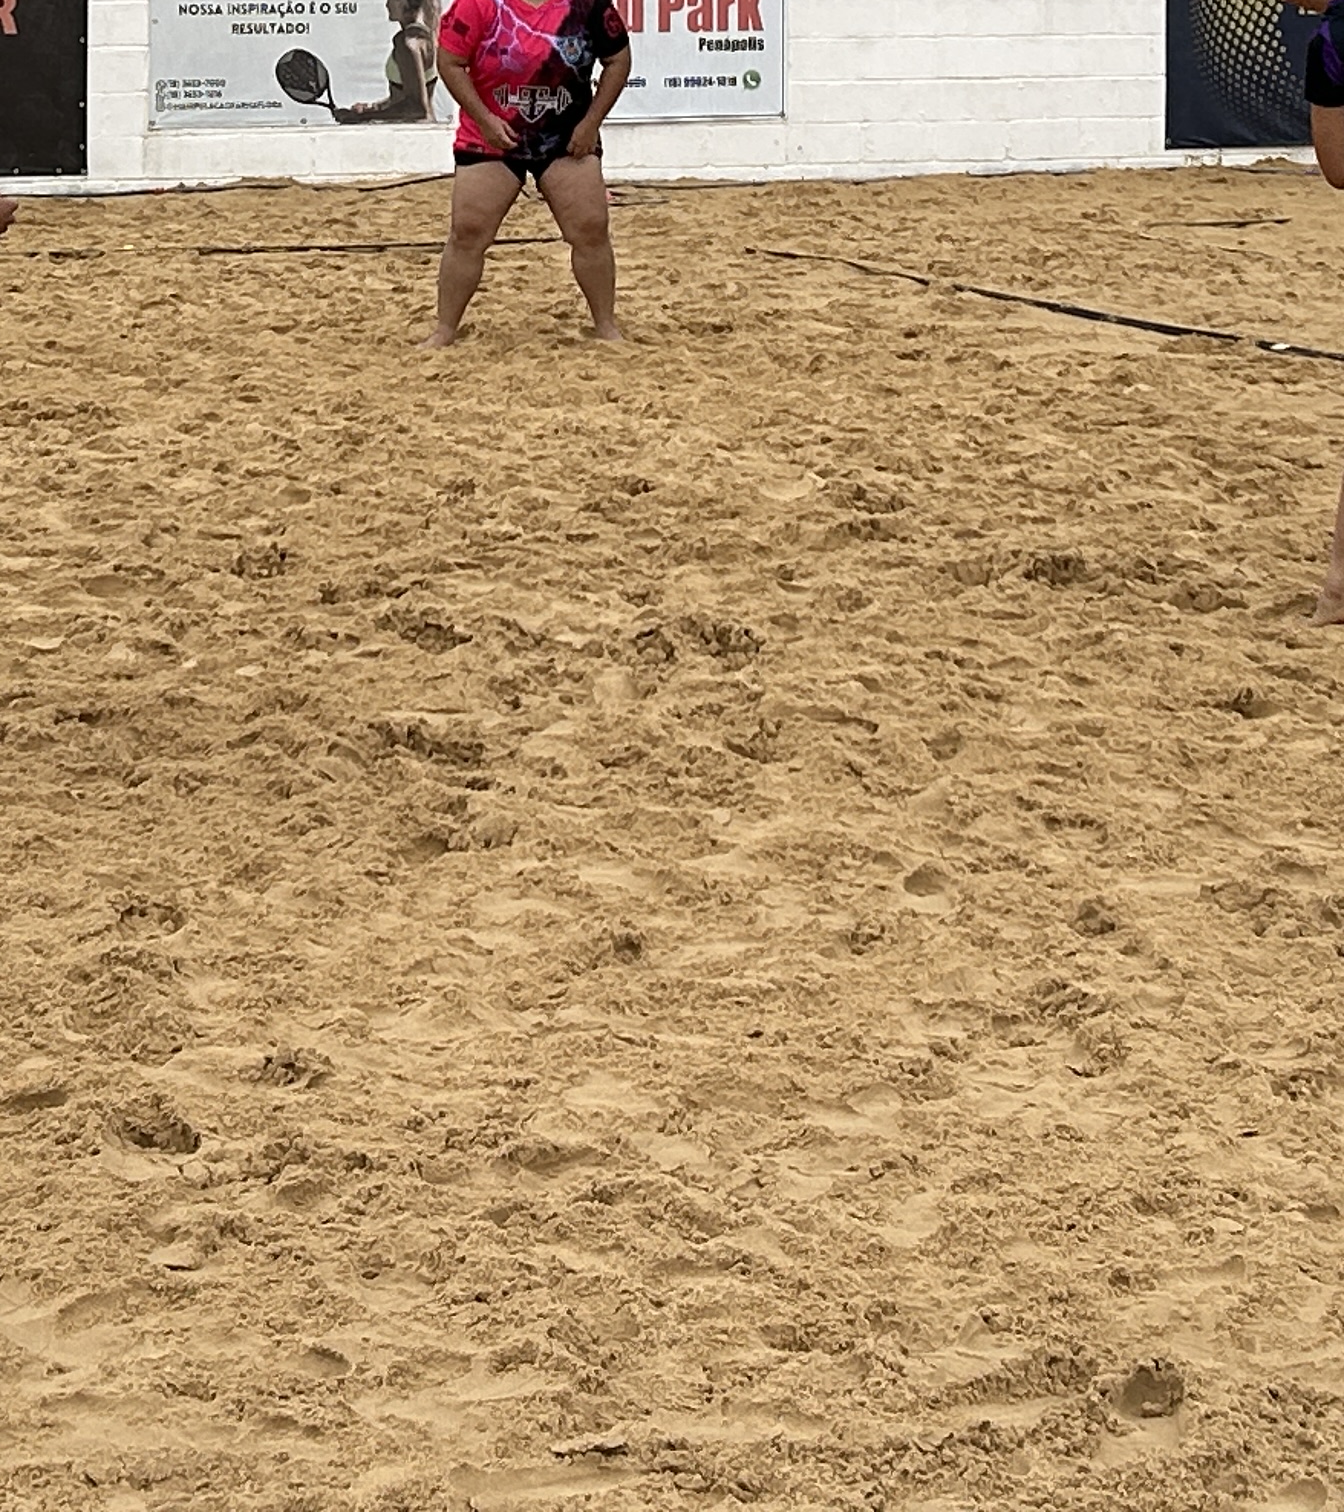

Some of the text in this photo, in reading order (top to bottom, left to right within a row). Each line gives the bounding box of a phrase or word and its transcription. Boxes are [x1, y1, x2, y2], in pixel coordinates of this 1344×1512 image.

[178, 0, 358, 18] NOSSA INSPIRAÇÃO É O SEU
[231, 22, 311, 35] RESULTADO!
